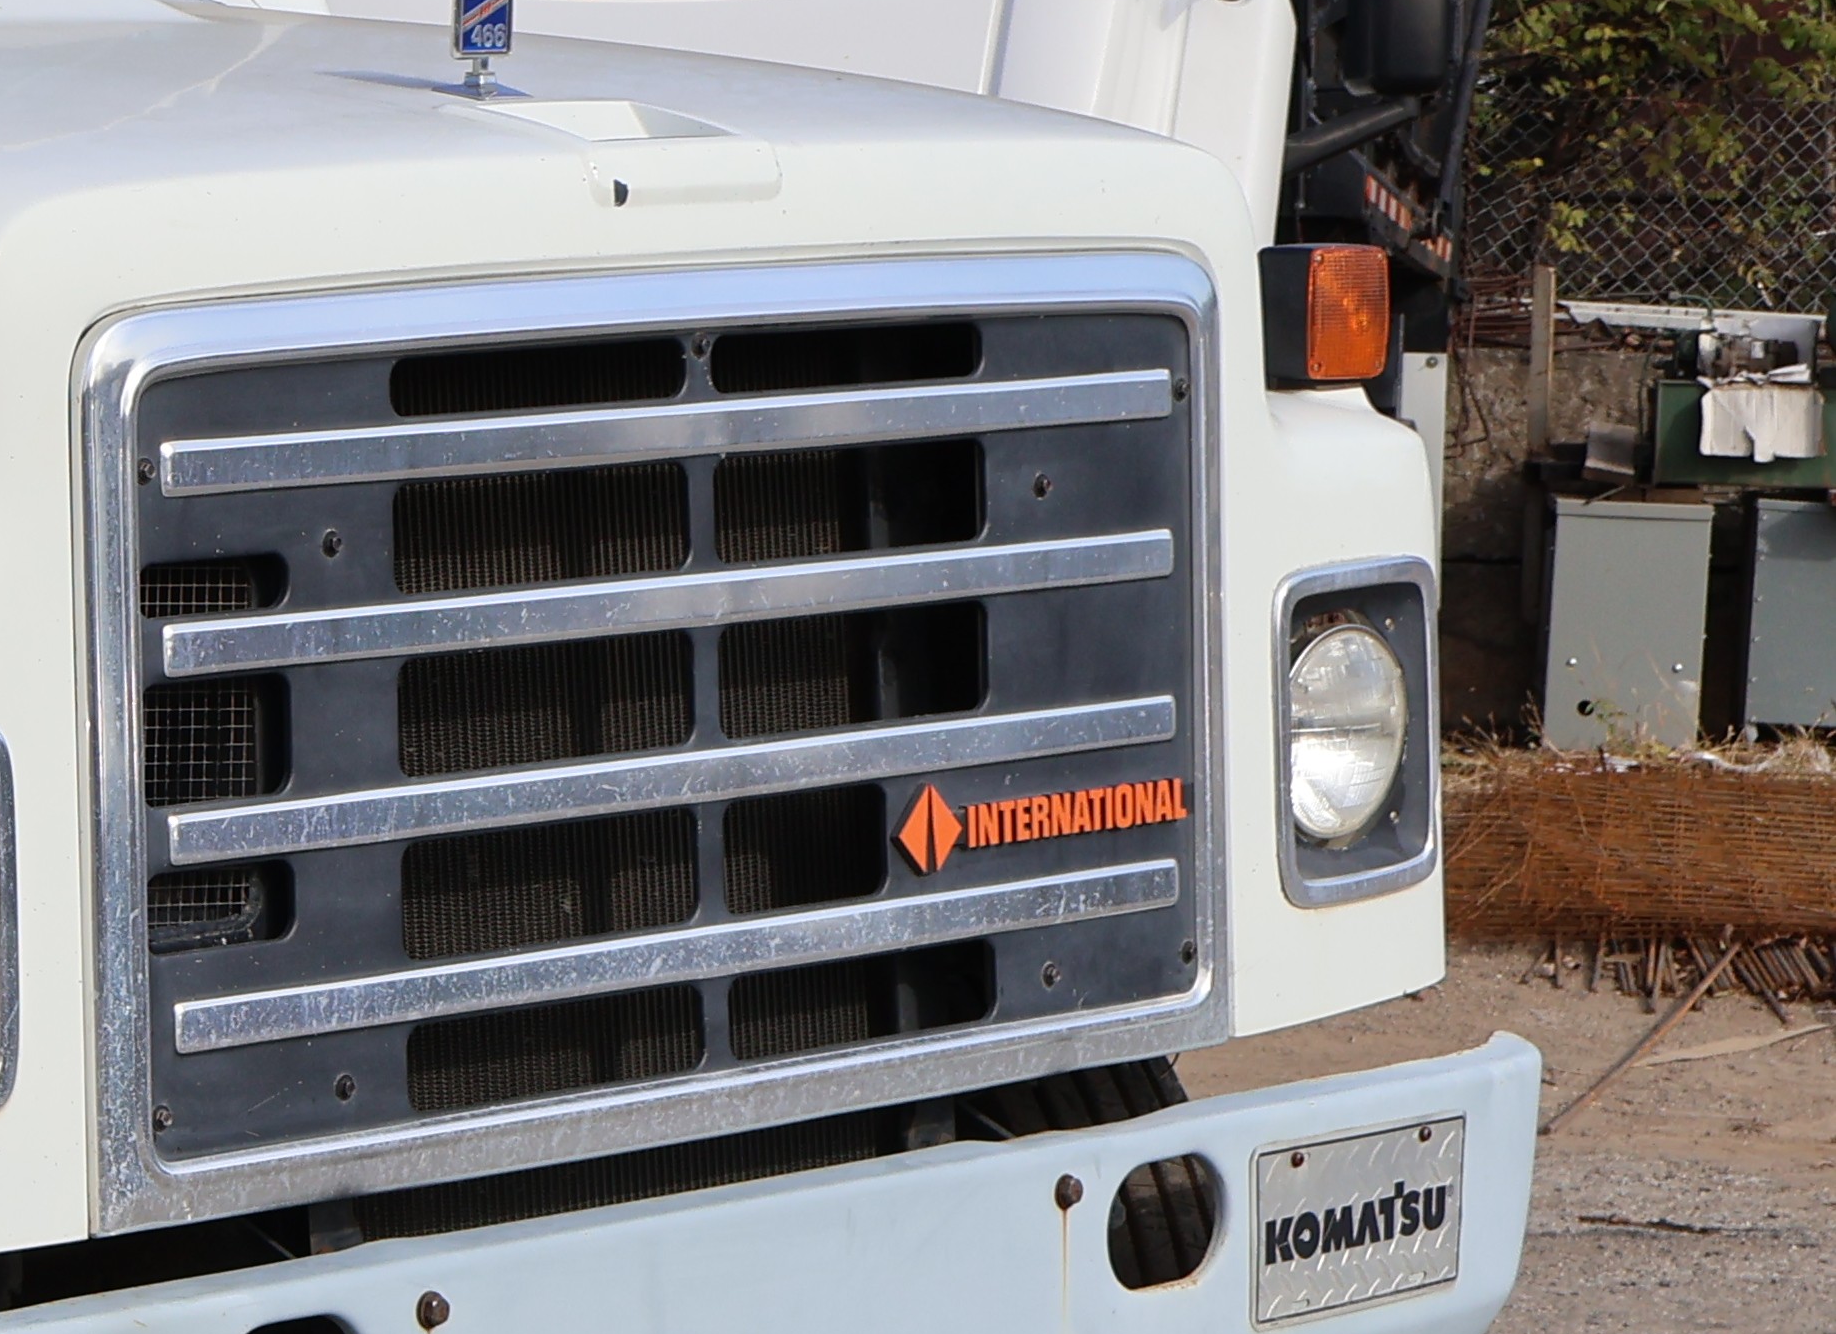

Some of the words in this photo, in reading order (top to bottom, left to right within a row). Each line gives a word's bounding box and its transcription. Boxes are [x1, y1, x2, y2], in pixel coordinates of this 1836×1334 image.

[470, 23, 507, 48] 466
[967, 777, 1188, 849] INTERNATIONAL
[1264, 1180, 1447, 1265] KOMATSU
